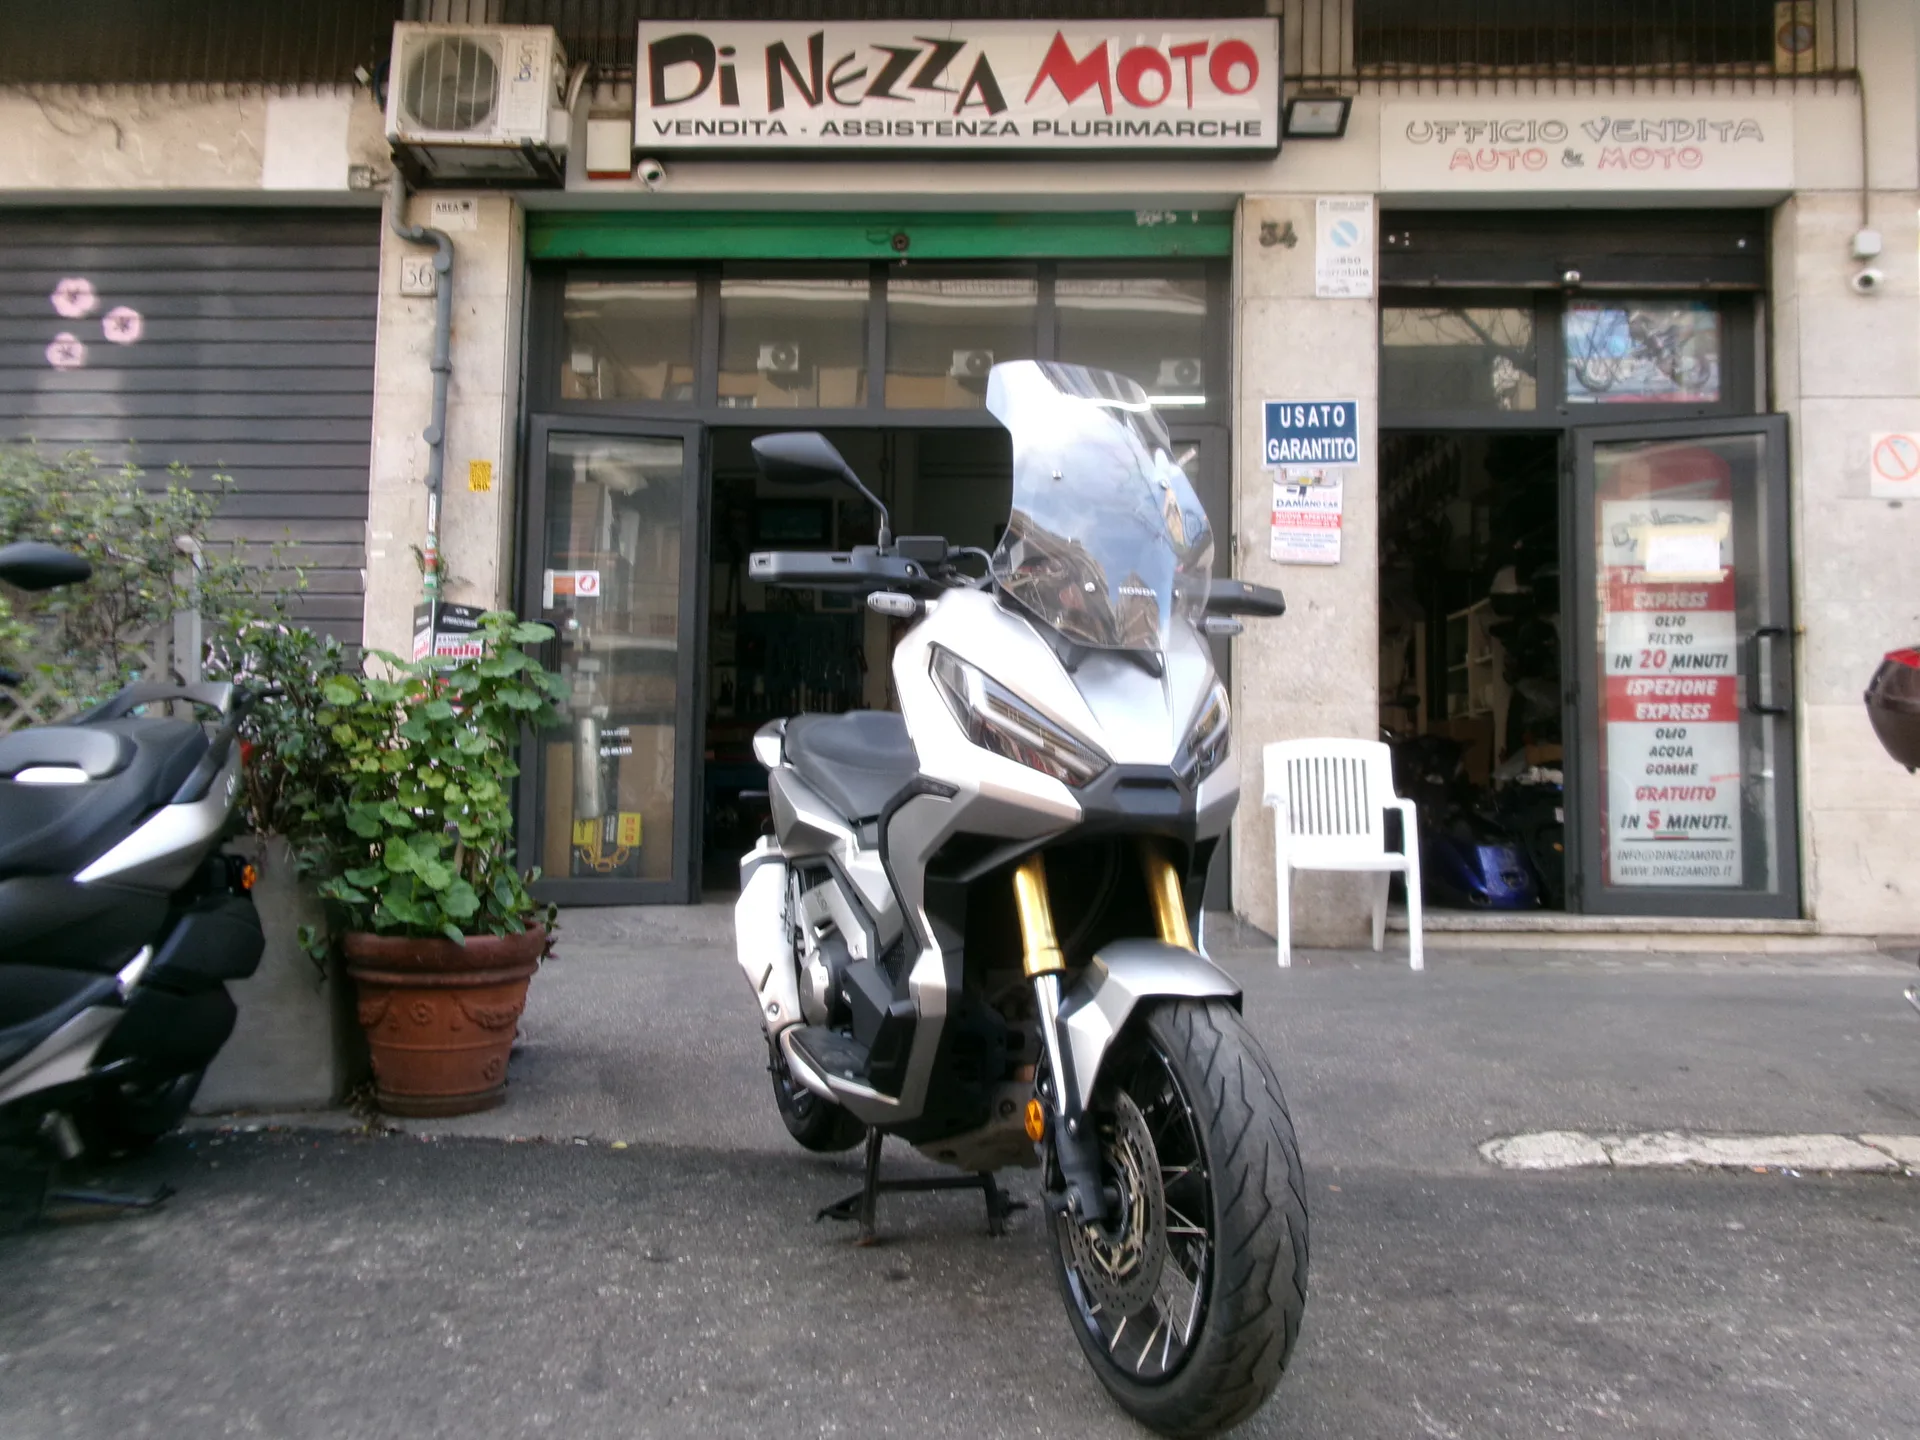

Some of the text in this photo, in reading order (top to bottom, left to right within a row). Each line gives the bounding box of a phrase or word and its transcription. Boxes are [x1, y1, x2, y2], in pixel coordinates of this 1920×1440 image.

[1024, 29, 1259, 116] MOTO
[653, 119, 788, 136] VENDITA
[819, 119, 1020, 137] ASSISTENZA
[1032, 119, 1262, 137] PLURIMARCHE
[1406, 116, 1764, 145] UFFICIO VENDITA
[1448, 147, 1704, 171] AUTO & MOTO
[1280, 405, 1346, 428] USATO
[1267, 437, 1356, 461] GARANTITO
[1118, 586, 1157, 597] HONDA
[1655, 615, 1686, 627] OLIO
[1648, 633, 1694, 645] FILTRO
[1614, 649, 1729, 669] IN 20 MINUTI
[1626, 678, 1718, 697] ISPEZIONE
[1636, 702, 1711, 721] EXPRESS
[1655, 728, 1687, 740] OLIO
[1649, 746, 1694, 758] ACQUA
[1645, 763, 1698, 776] GOMME
[1635, 786, 1717, 802] GRATUITO
[1620, 814, 1640, 830] IN
[1647, 810, 1660, 830] 5
